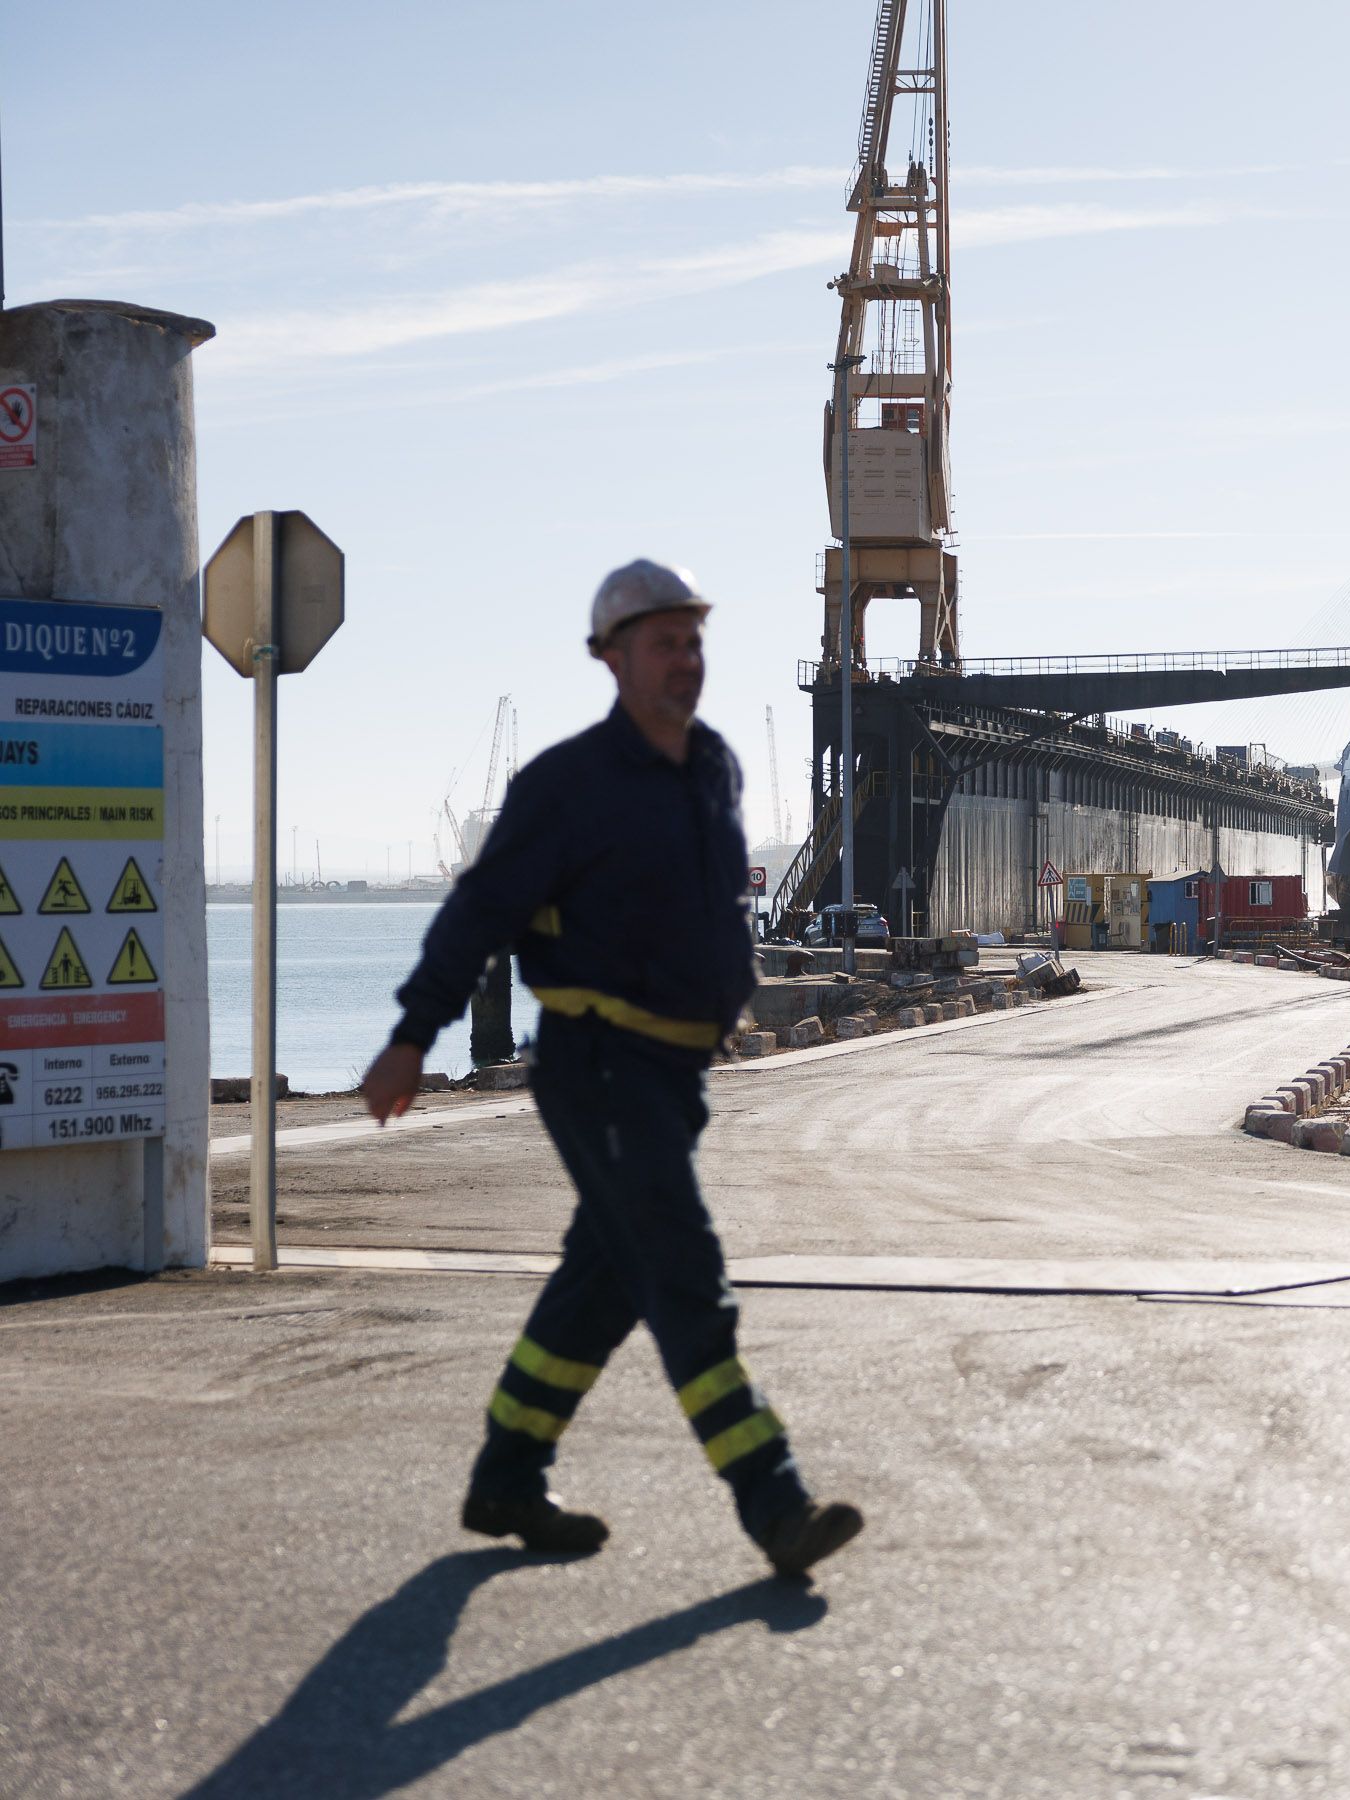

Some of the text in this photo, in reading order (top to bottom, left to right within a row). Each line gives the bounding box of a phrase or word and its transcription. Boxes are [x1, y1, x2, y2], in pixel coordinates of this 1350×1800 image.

[5, 622, 136, 660] DIQUE Nº2
[15, 697, 154, 720] REPARACIONES CÁDIZ
[0, 741, 38, 765] AYS
[21, 805, 91, 821] PRINCIPALES
[100, 806, 126, 821] MAIN
[129, 807, 155, 821] RISK
[752, 873, 762, 881] 10
[8, 1012, 68, 1028] EMERGENCIA
[73, 1010, 128, 1025] EMERGENCY
[44, 1053, 150, 1070] Interno Externo
[44, 1086, 82, 1105] 6222
[50, 1113, 152, 1138] 151.900 Mhz
